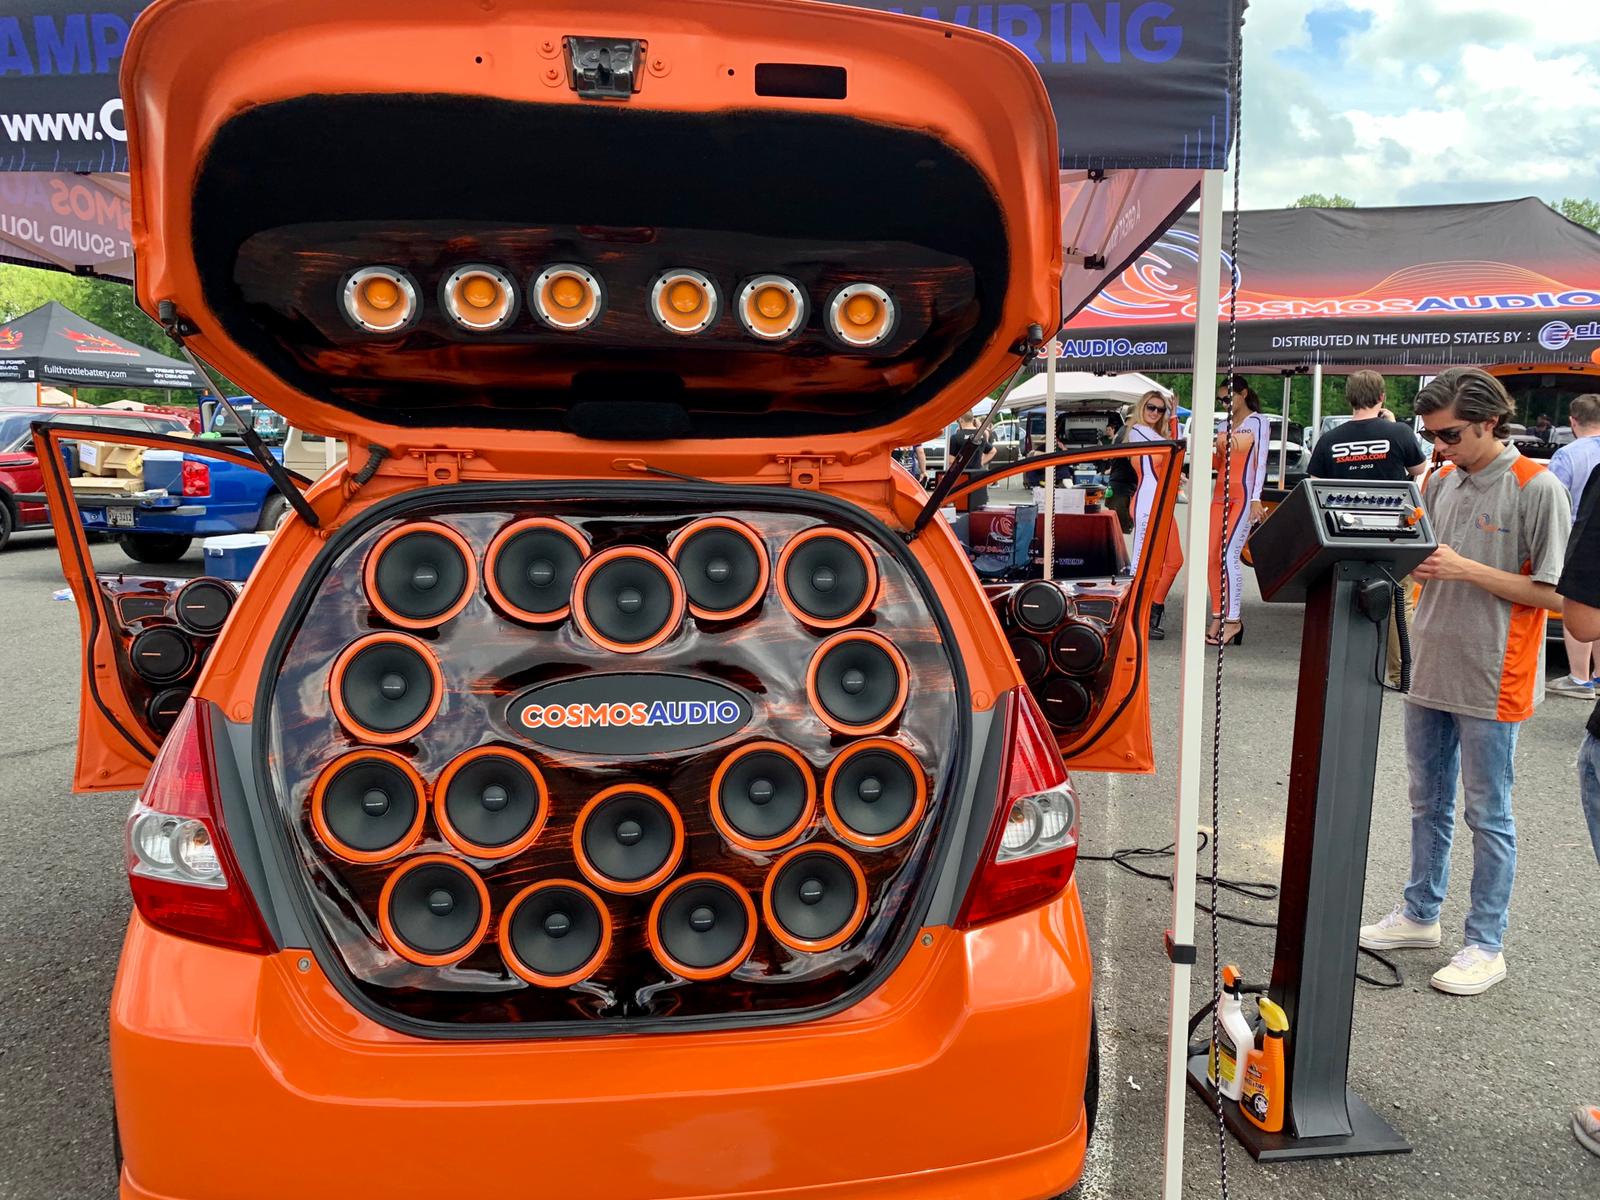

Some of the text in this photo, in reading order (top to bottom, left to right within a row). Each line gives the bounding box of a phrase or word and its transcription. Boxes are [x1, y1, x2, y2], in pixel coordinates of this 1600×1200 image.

[888, 2, 1184, 64] RING
[1272, 334, 1353, 348] DISTRIBUTED
[1356, 334, 1370, 346] IN
[1373, 333, 1398, 346] THE
[1401, 332, 1450, 345] UNITED
[1454, 331, 1500, 344] STATES
[1504, 331, 1522, 343] BY
[44, 365, 127, 379] fullthrottlebattery.com
[521, 700, 740, 728] COSMOSAUDIO
